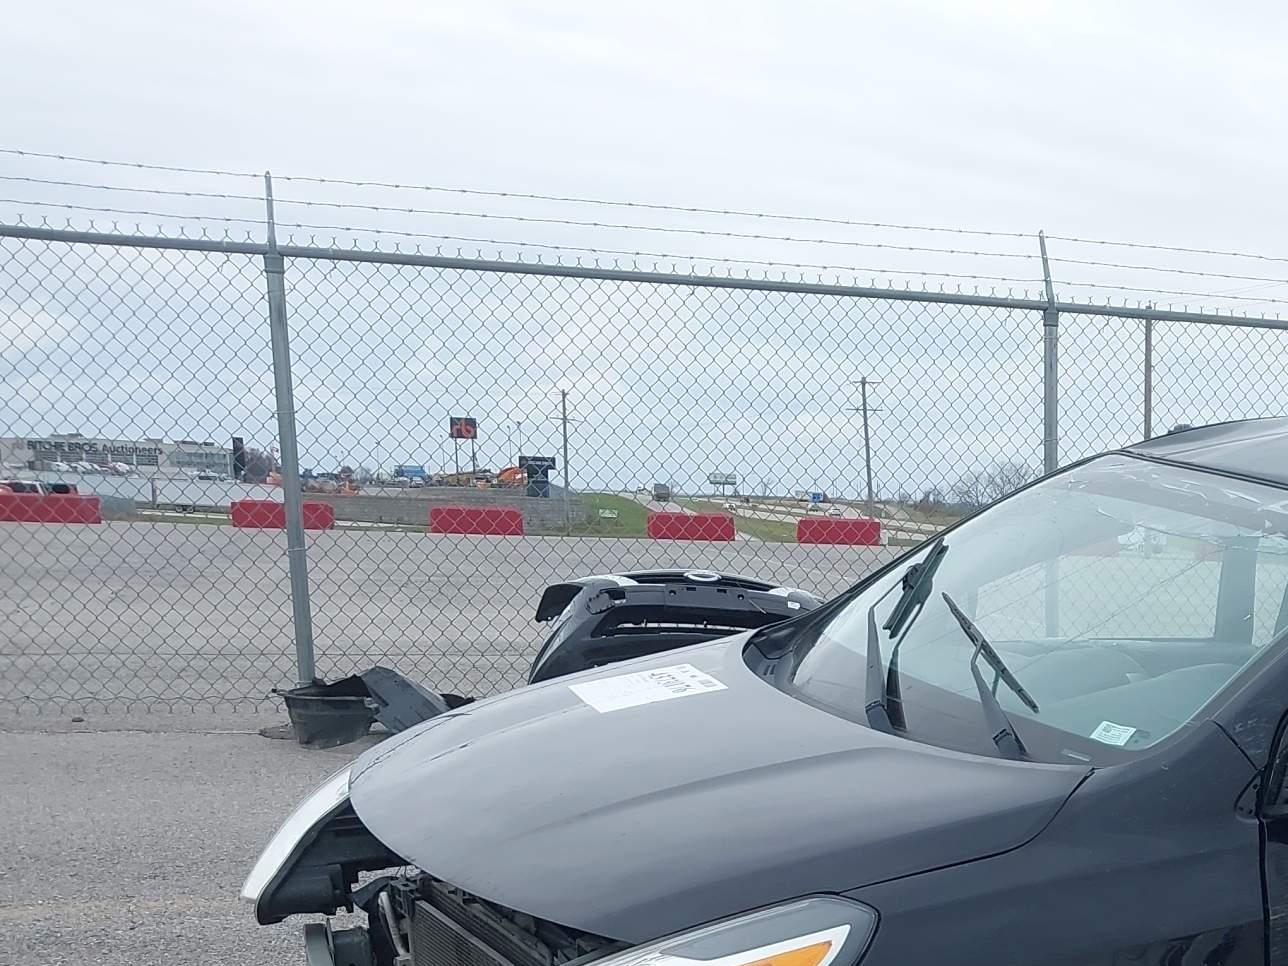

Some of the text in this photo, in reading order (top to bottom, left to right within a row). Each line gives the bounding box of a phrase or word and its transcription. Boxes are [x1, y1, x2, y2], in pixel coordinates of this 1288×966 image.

[27, 440, 66, 451] RITCHIE
[67, 442, 98, 452] BROS
[102, 444, 163, 455] Auctioneers
